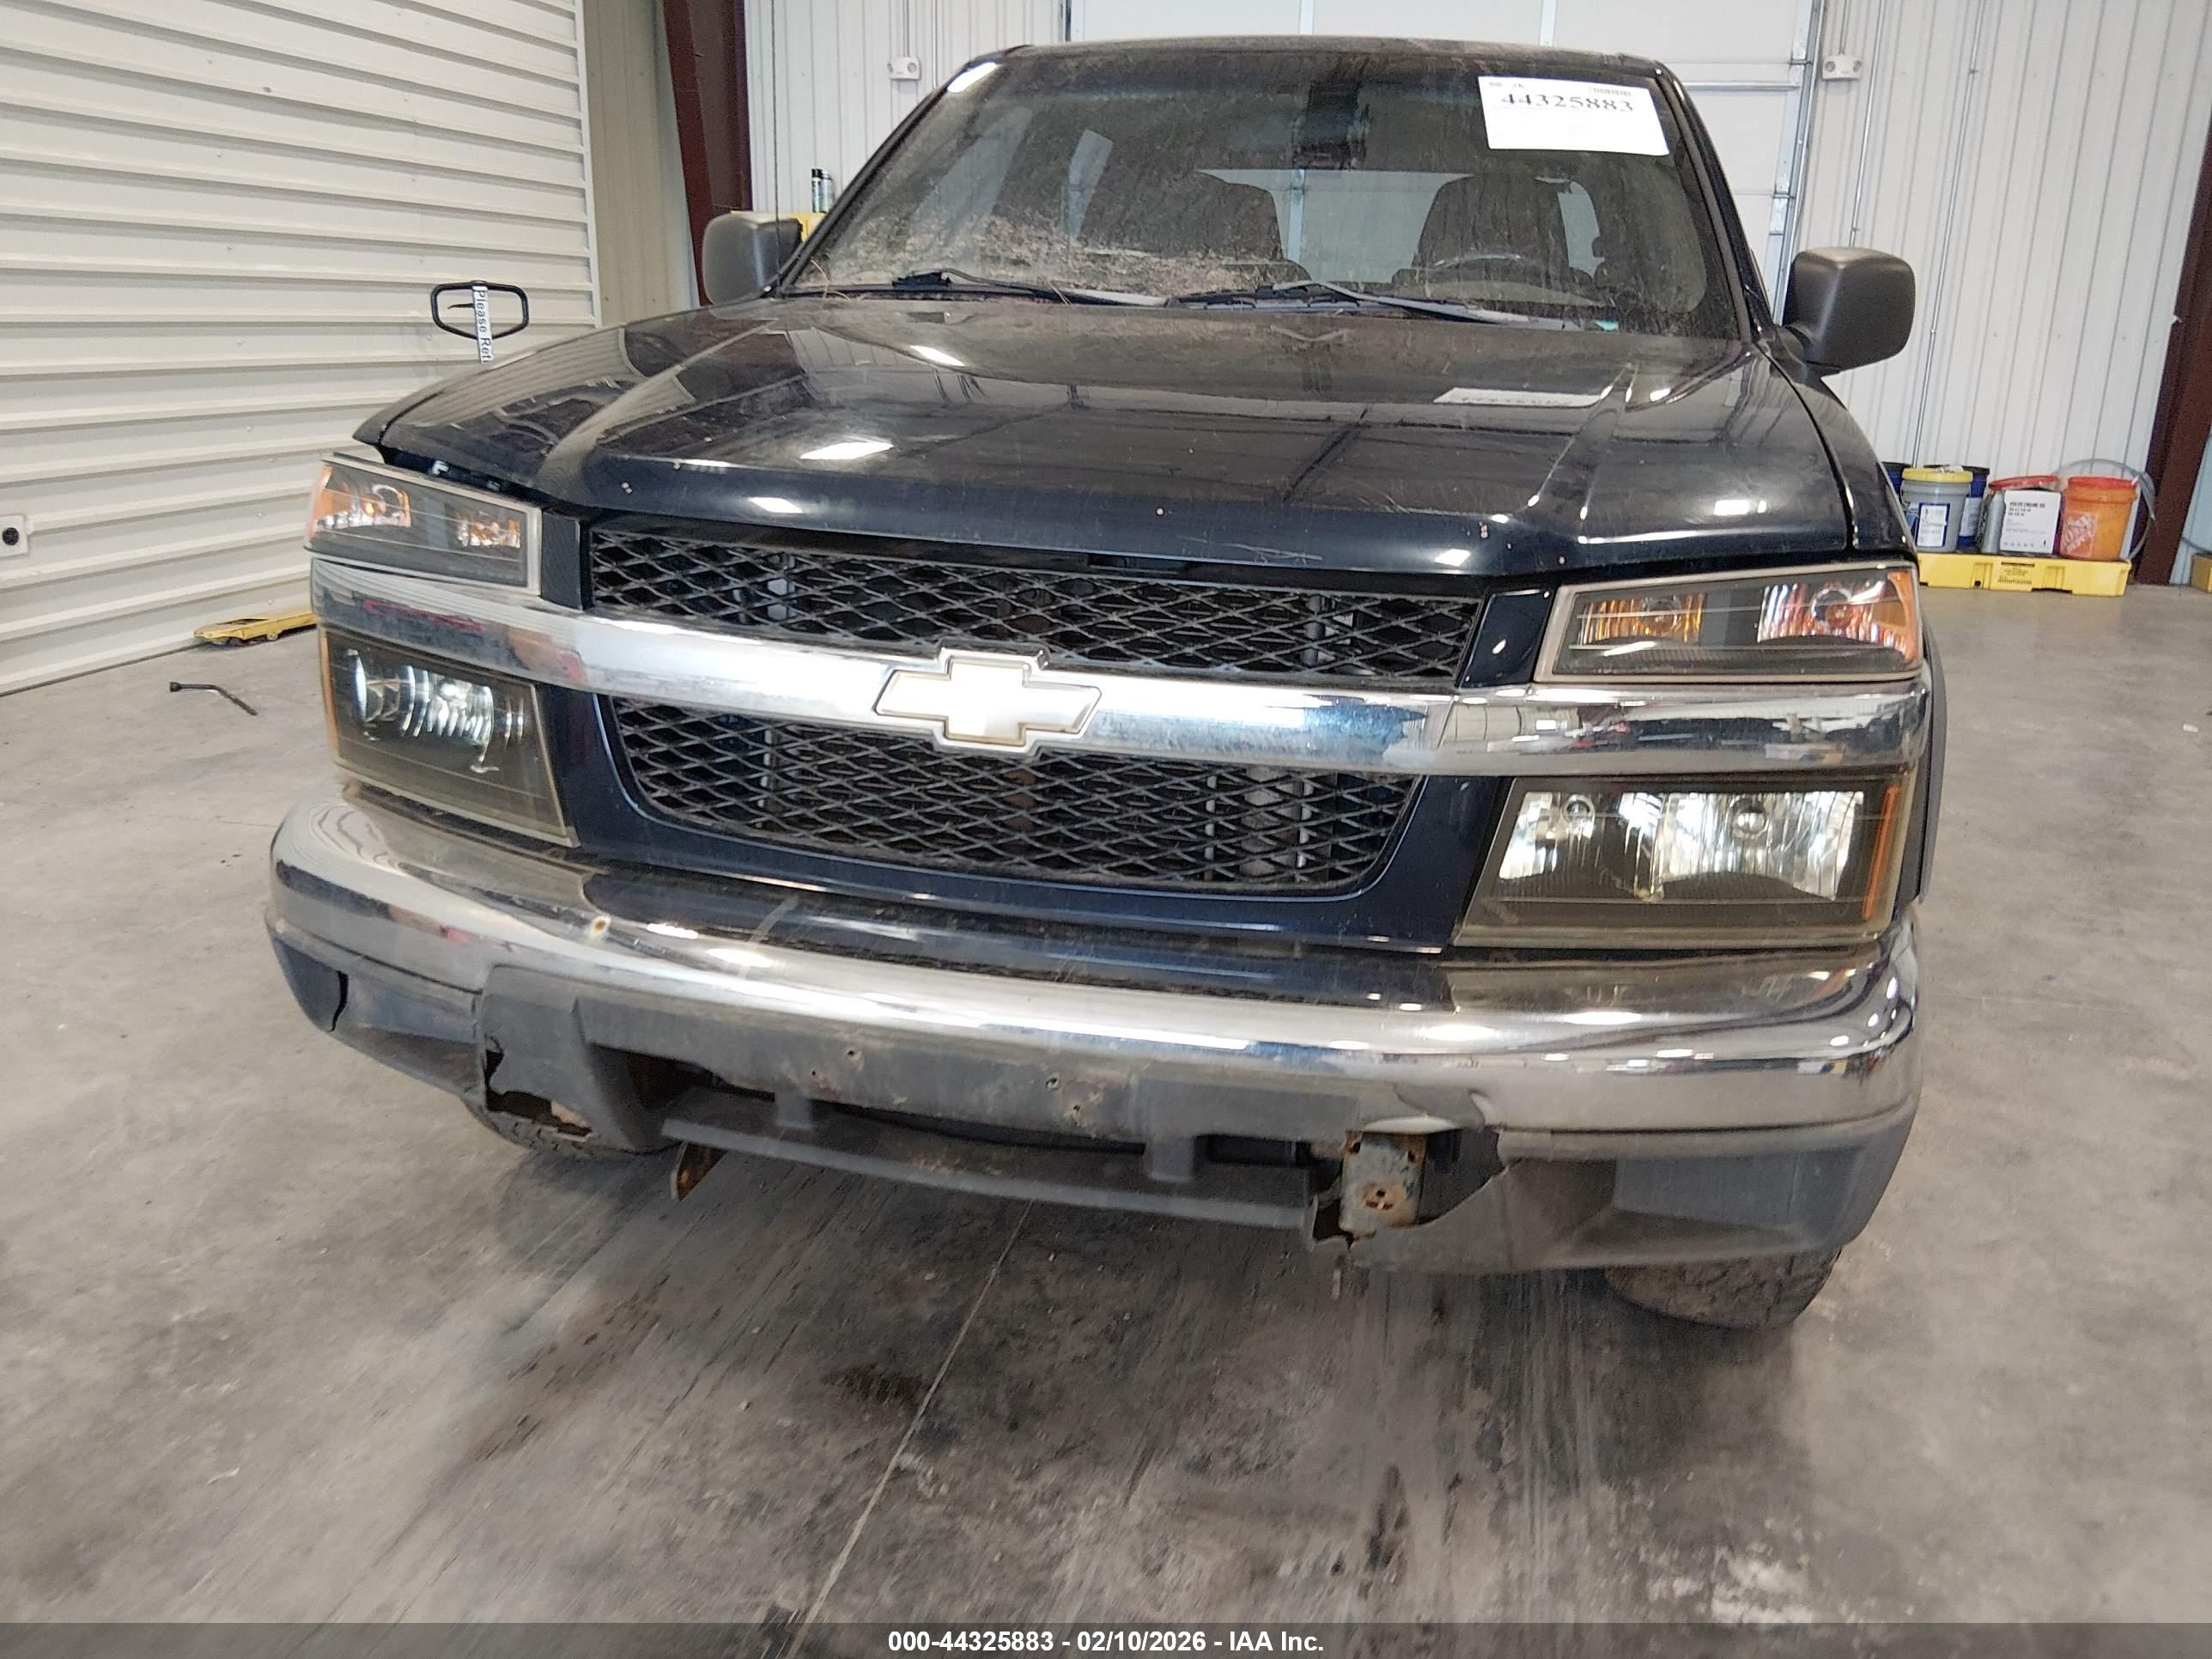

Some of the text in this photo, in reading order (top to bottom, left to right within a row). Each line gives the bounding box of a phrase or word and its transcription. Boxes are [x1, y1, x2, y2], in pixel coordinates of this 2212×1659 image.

[1501, 93, 1634, 112] 44325883
[473, 289, 492, 362] Please Ret
